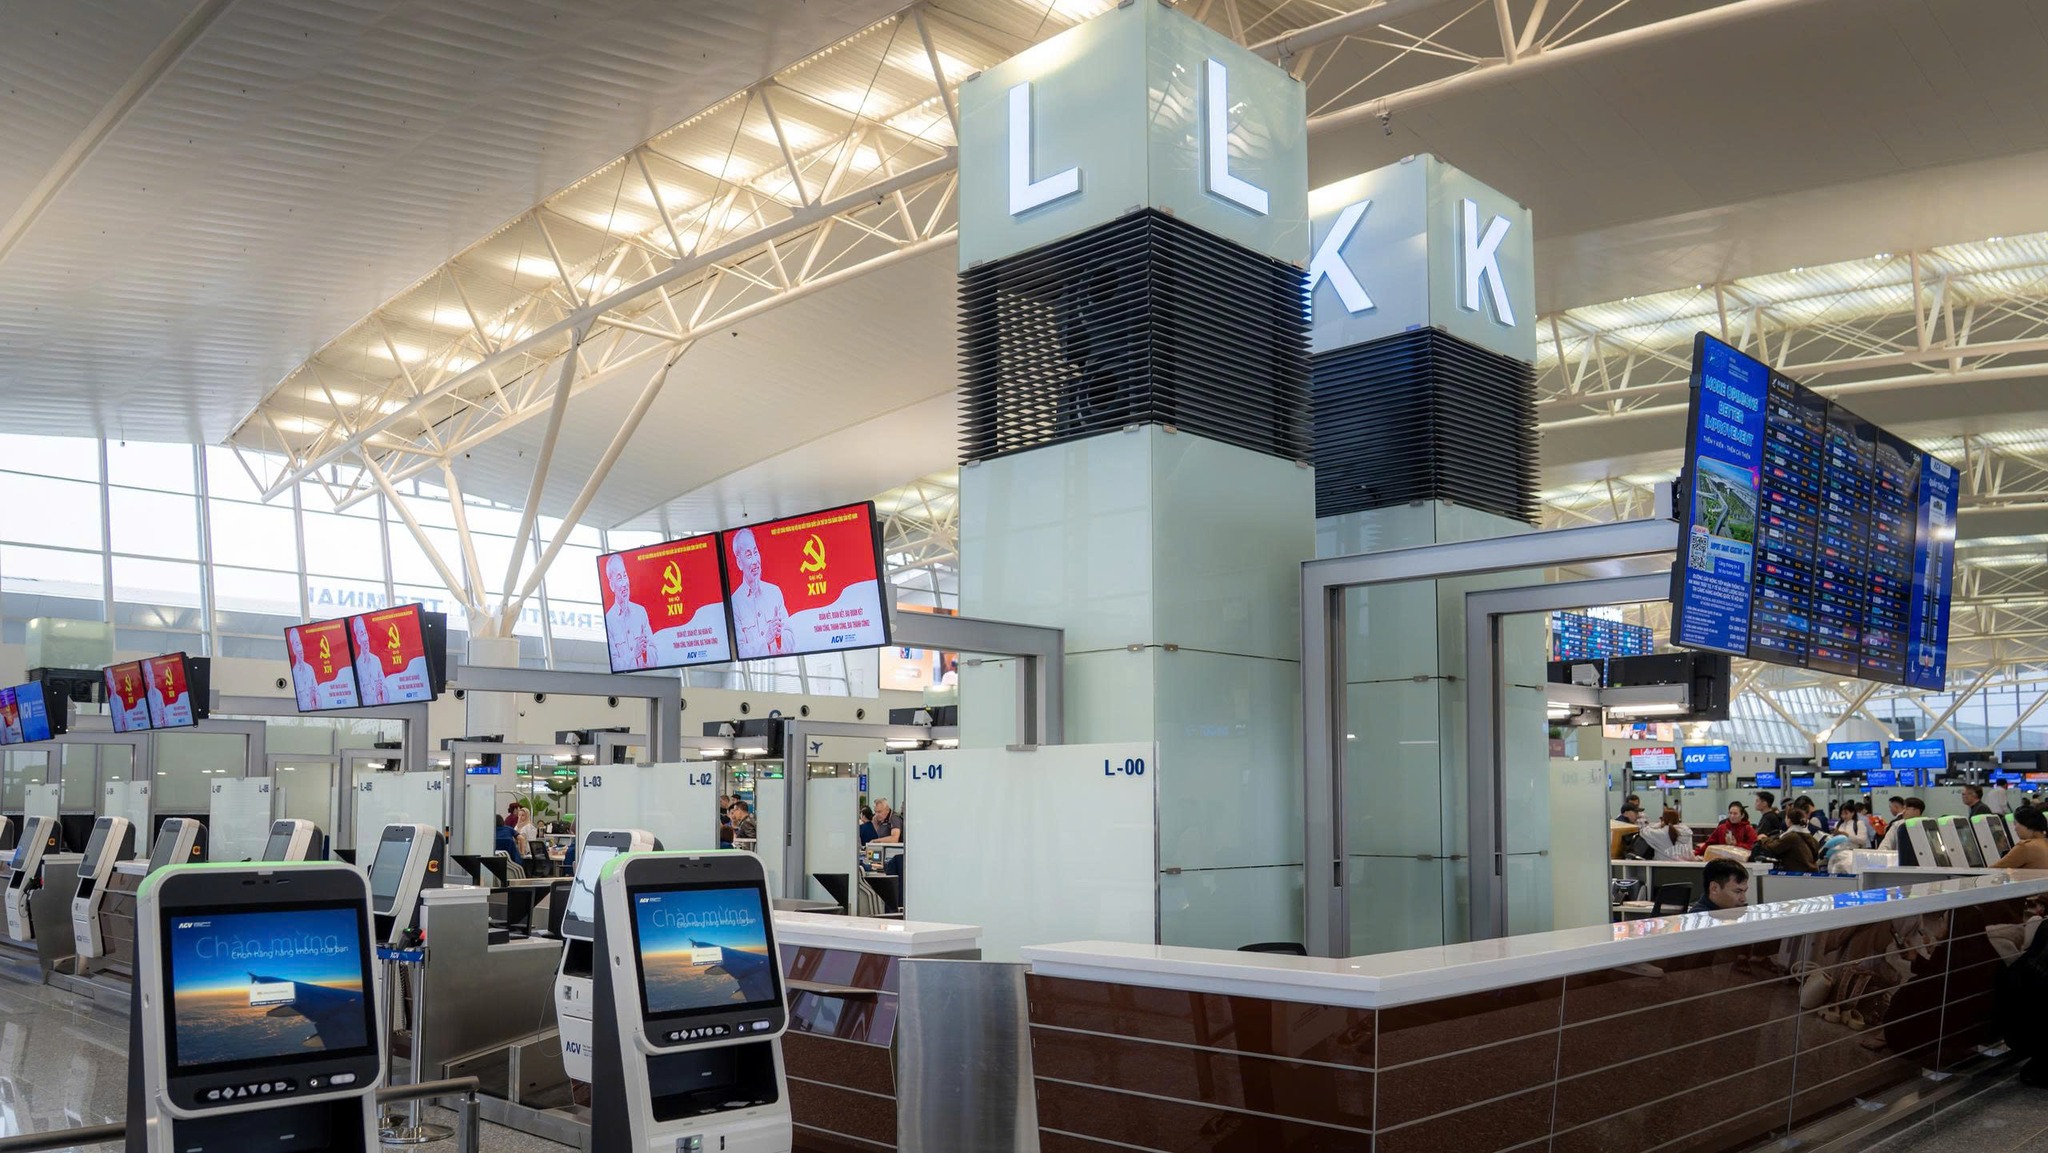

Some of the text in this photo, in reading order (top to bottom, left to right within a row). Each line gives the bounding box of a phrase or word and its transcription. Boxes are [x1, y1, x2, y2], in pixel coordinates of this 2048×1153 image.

[1203, 57, 1270, 217] L
[1008, 80, 1082, 217] L
[1309, 199, 1375, 314] K
[1462, 197, 1516, 328] K
[1718, 400, 1744, 425] BETTER
[1704, 414, 1754, 447] IMPROVEMENT
[807, 581, 827, 596] XIV
[667, 603, 684, 616] XIV
[831, 635, 844, 644] ACV
[1685, 754, 1706, 763] ACV
[1830, 751, 1854, 760] ACV
[1892, 749, 1917, 759] ACV
[913, 764, 943, 780] L-01
[1105, 758, 1145, 776] L-00
[360, 782, 372, 792] L-05
[427, 780, 442, 791] L-04
[583, 776, 602, 788] L-03
[690, 773, 712, 786] L-02
[652, 905, 749, 927] Chào mừng
[195, 930, 338, 959] Chào mừng
[565, 1040, 581, 1055] ACV
